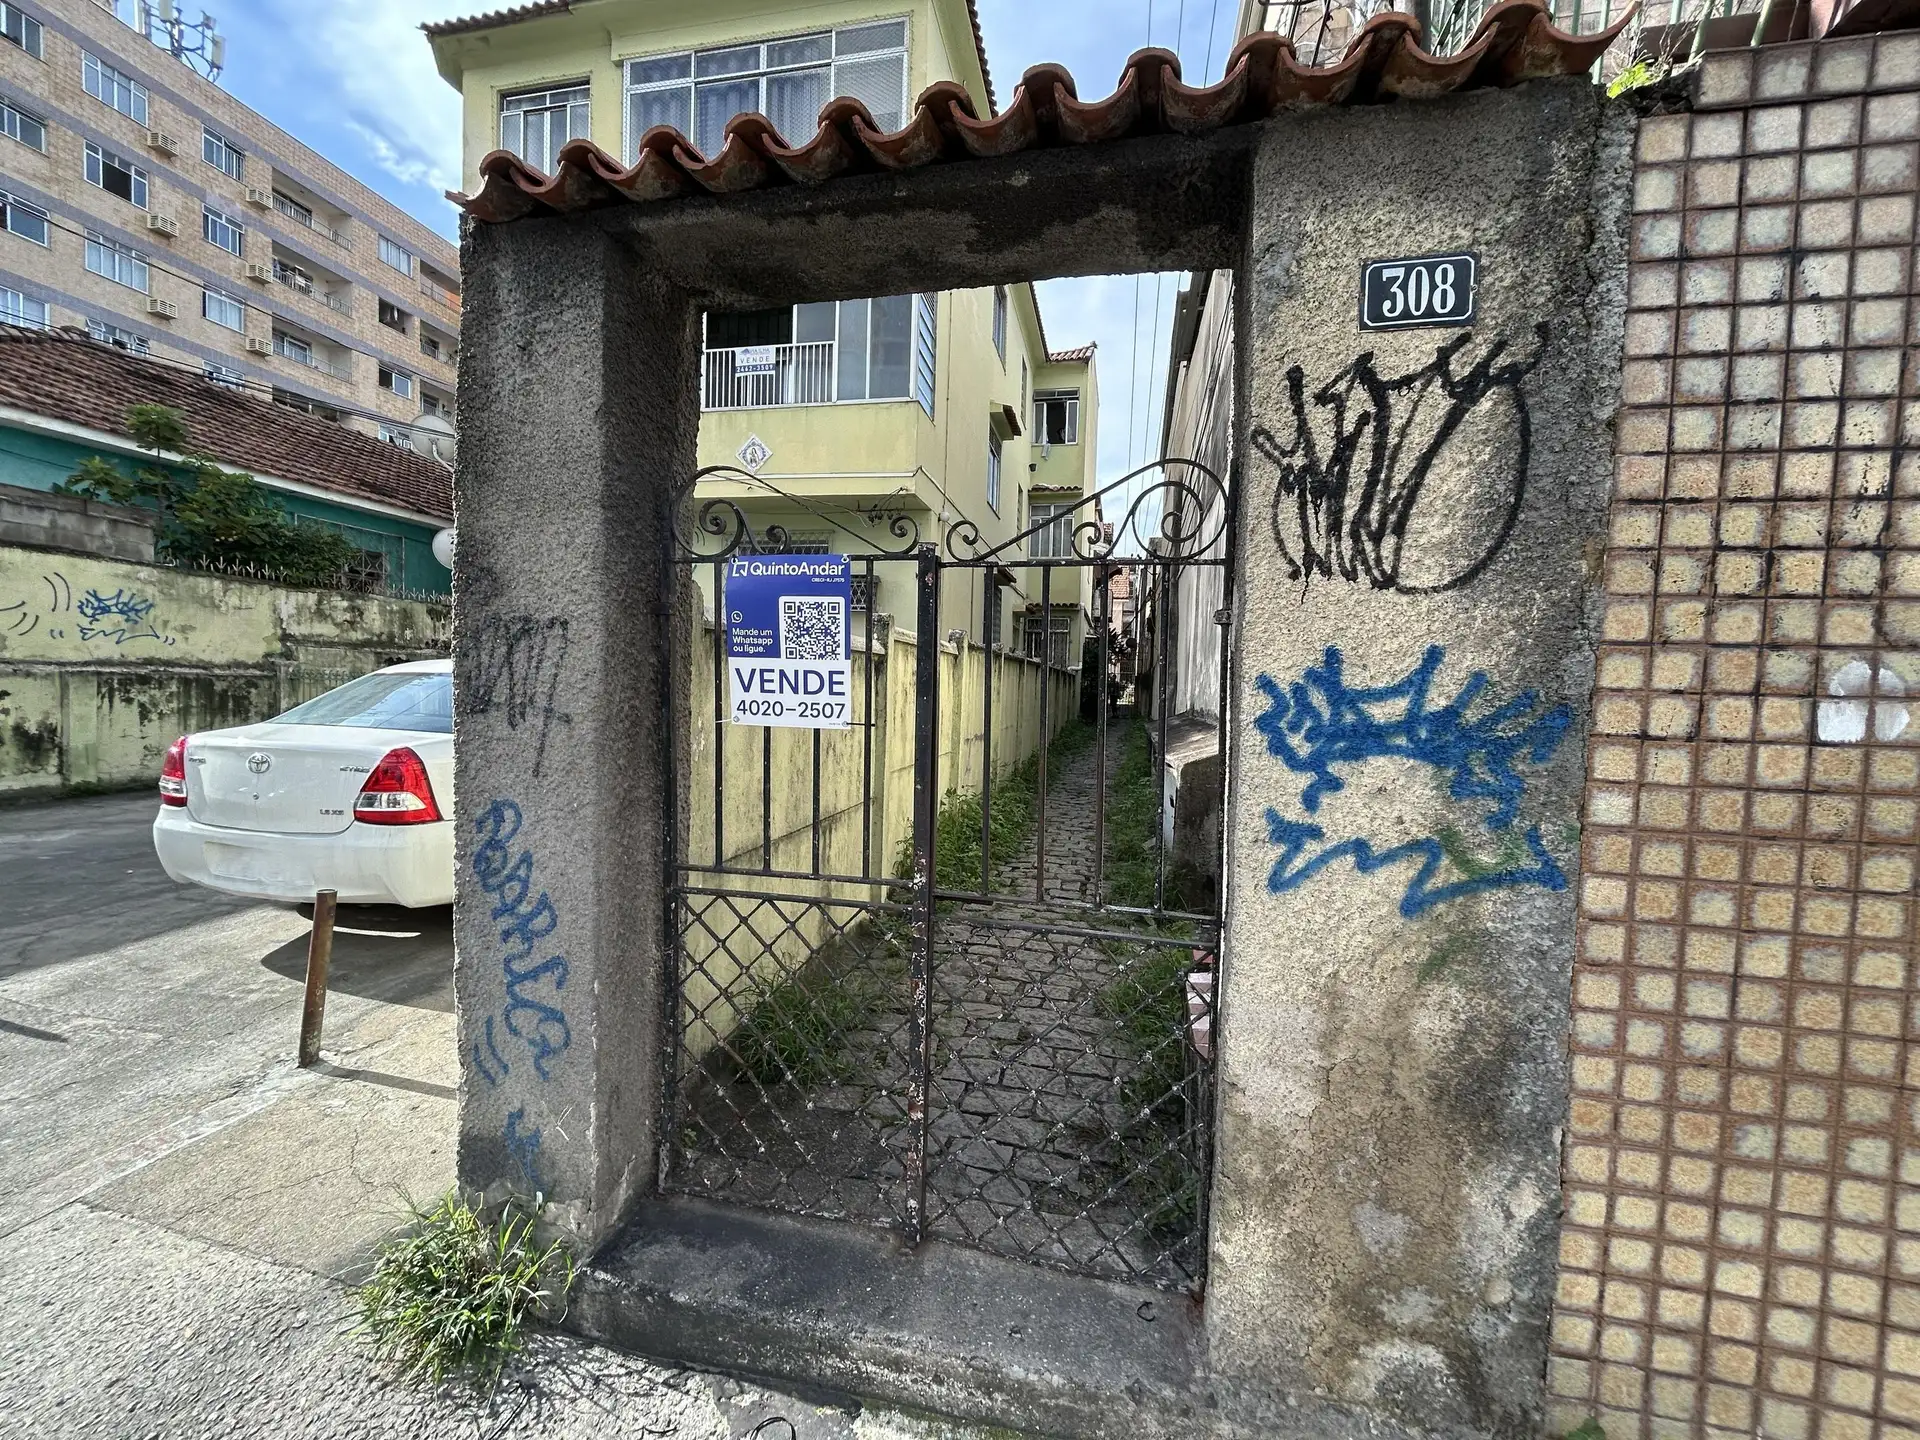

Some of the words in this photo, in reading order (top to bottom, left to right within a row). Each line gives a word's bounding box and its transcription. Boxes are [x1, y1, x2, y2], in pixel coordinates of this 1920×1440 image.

[1382, 263, 1456, 317] 308
[740, 356, 770, 364] VENDE
[750, 562, 845, 576] QuintoAndar
[732, 628, 759, 636] Mande
[732, 636, 773, 645] Whatsapp
[744, 644, 766, 654] ligue.
[734, 667, 846, 696] VENDE
[736, 699, 846, 719] 4020-2507
